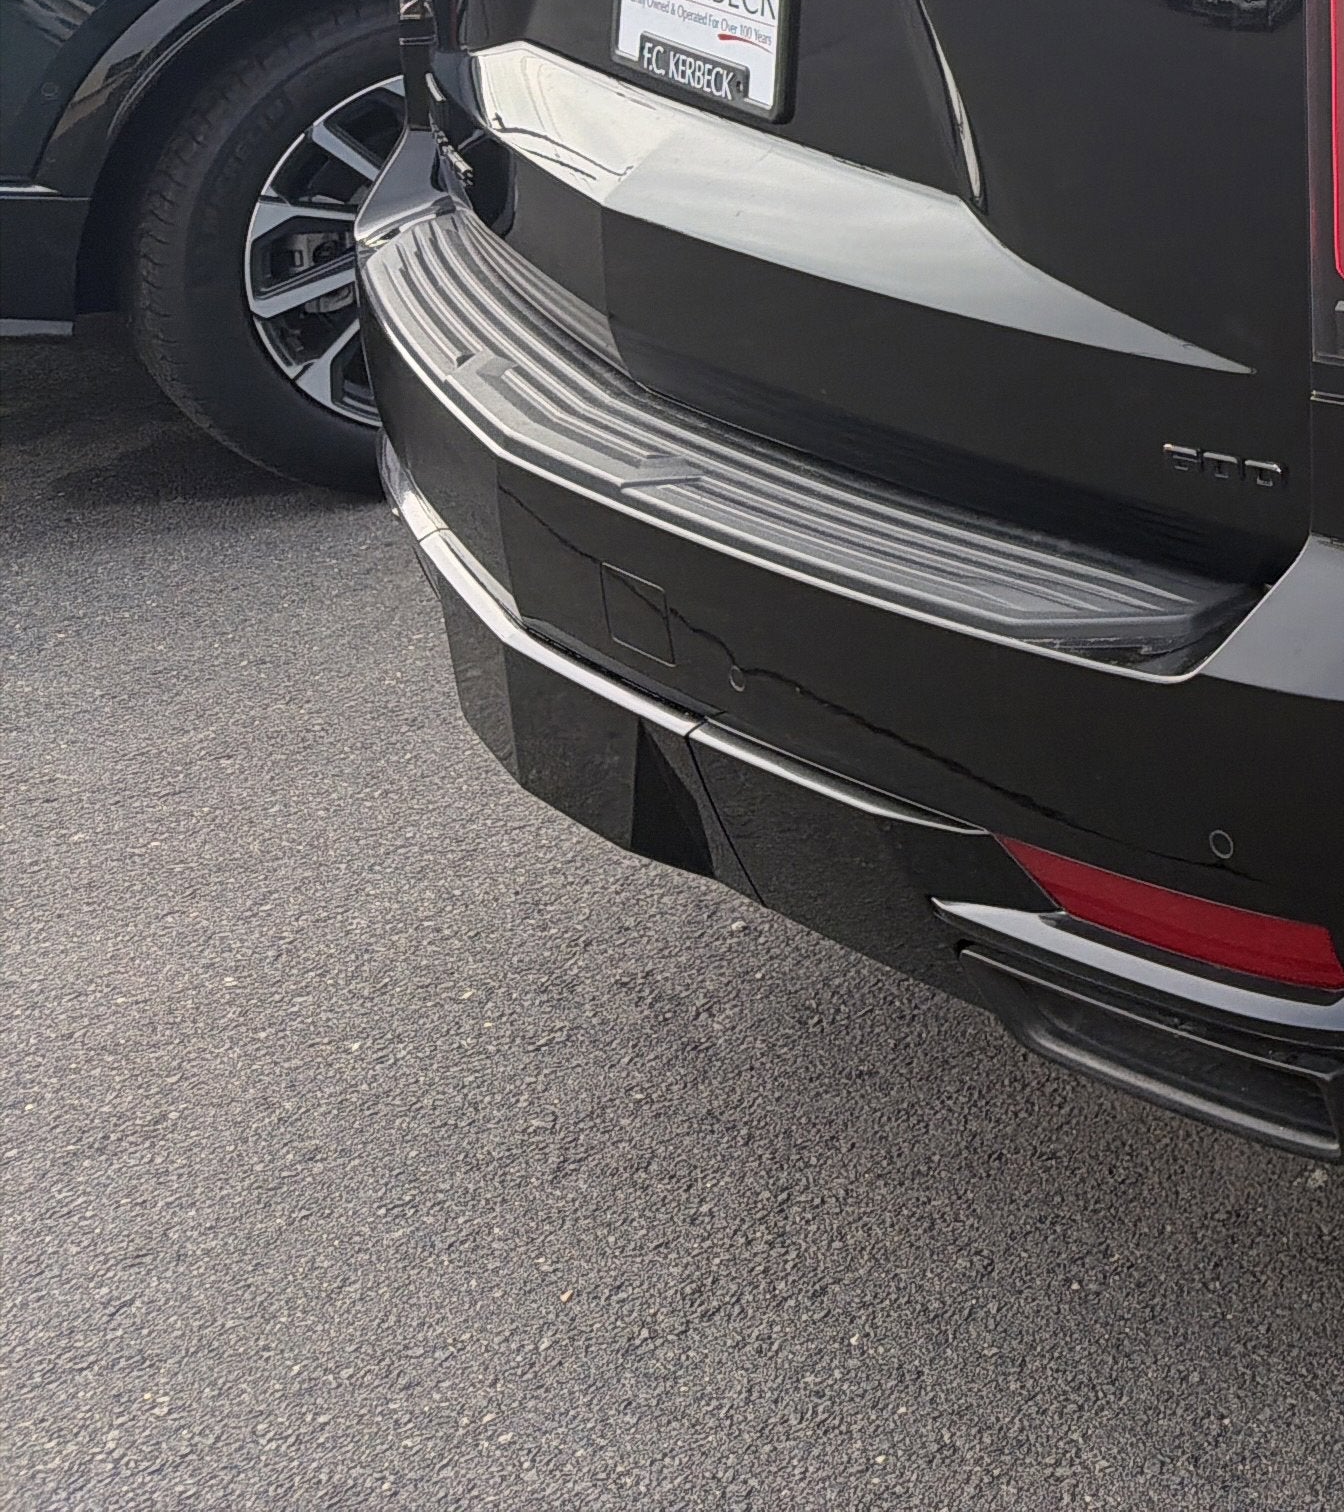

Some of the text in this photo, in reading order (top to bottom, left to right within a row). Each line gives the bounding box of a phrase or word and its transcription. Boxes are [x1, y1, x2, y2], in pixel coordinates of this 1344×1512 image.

[670, 2, 676, 16] &
[677, 5, 708, 27] Operated
[708, 13, 720, 29] For
[720, 18, 738, 34] Over
[739, 23, 753, 39] 100
[753, 27, 772, 46] Years
[643, 41, 734, 100] F.C. KERBECK
